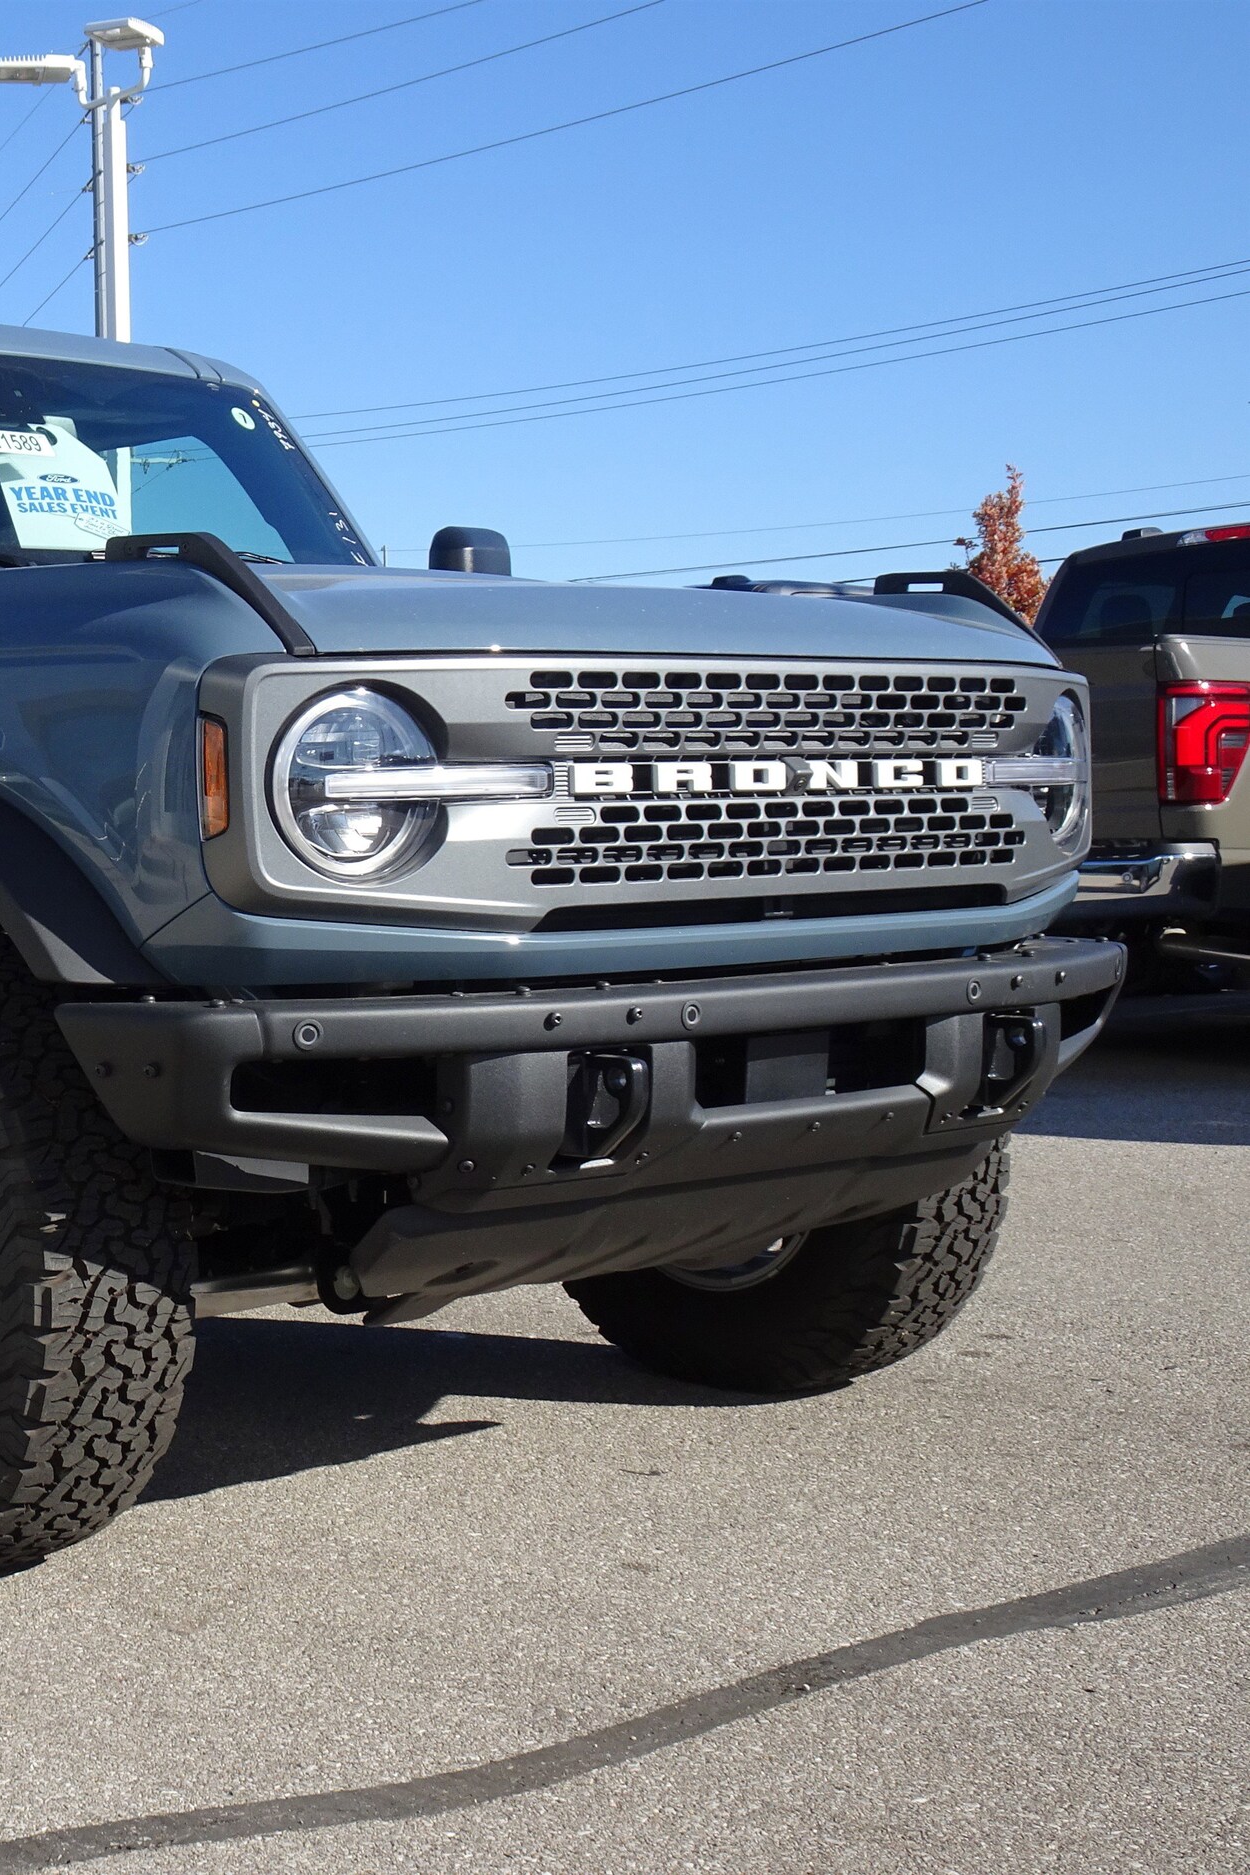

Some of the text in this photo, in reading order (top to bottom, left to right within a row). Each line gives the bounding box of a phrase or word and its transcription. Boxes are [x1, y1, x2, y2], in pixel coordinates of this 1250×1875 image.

[45, 474, 72, 483] Ford
[9, 486, 115, 507] YEAR END
[17, 502, 118, 520] SALES EVENT
[569, 758, 984, 794] BRONCO
